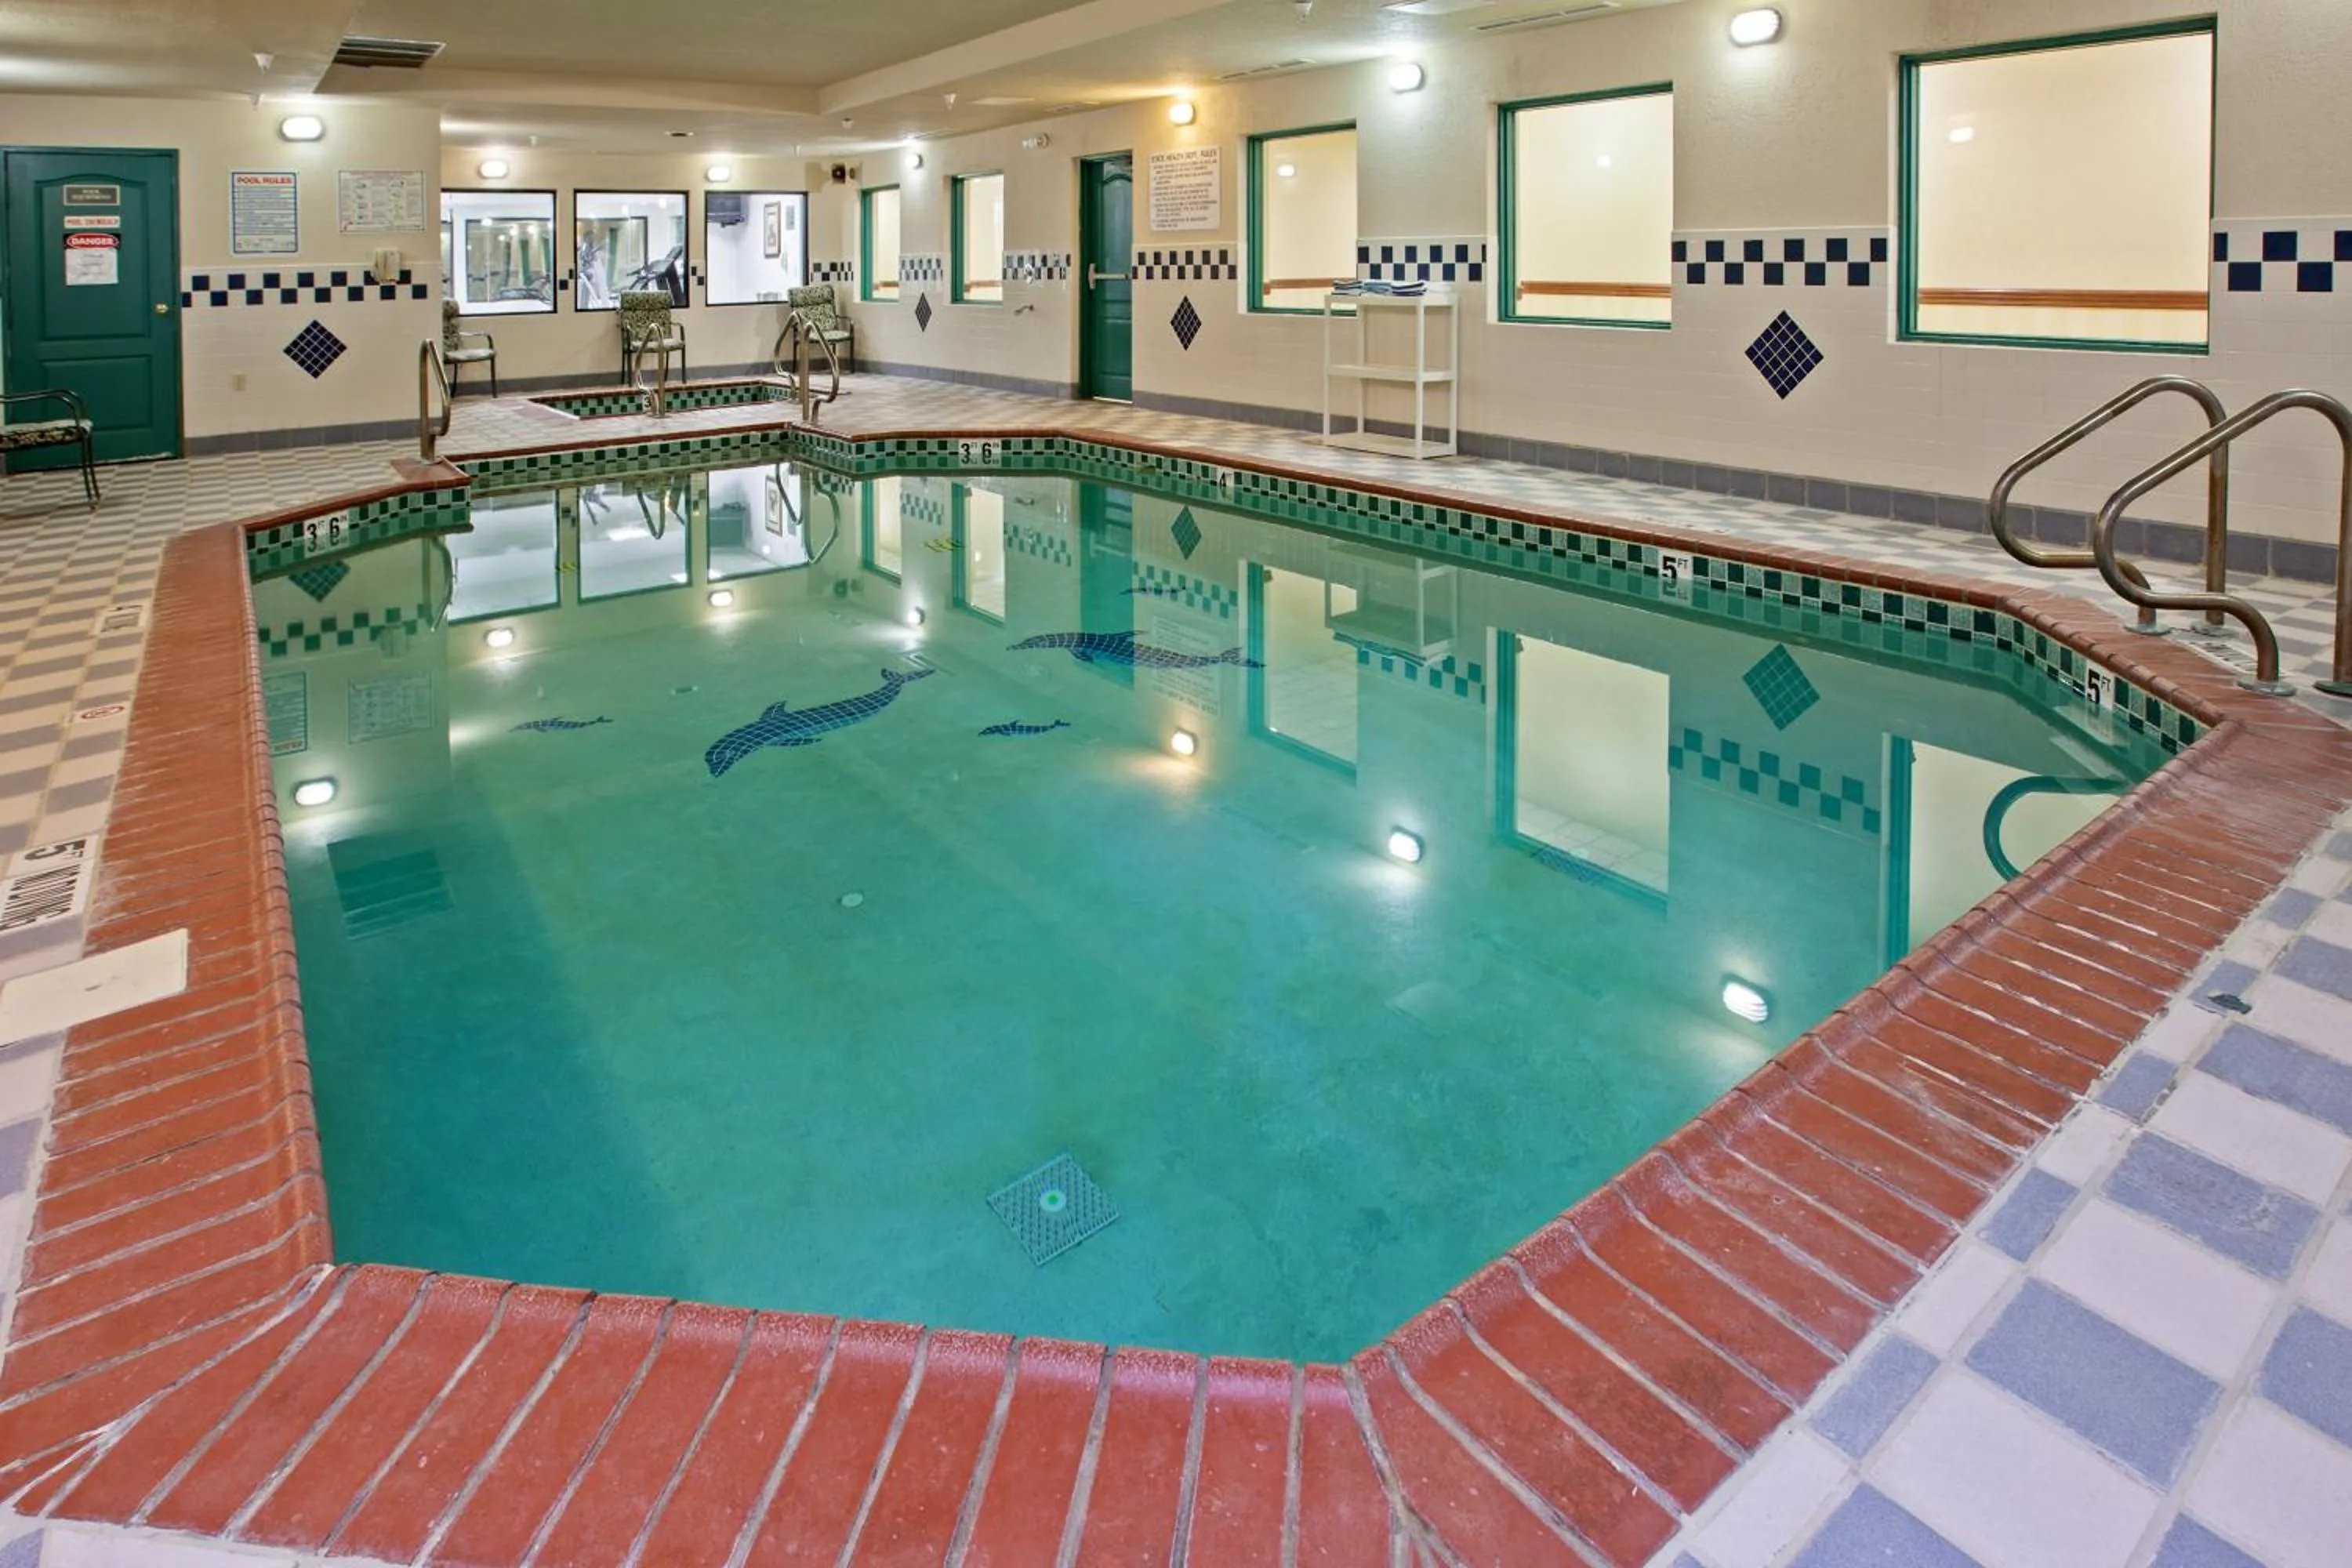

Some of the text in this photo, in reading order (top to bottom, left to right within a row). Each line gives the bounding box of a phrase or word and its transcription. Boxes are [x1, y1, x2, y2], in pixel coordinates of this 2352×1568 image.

[71, 237, 114, 245] DANGER
[961, 443, 971, 459] 3
[307, 523, 318, 541] 3
[1661, 556, 1689, 579] 5 FT
[2088, 668, 2100, 704] 5
